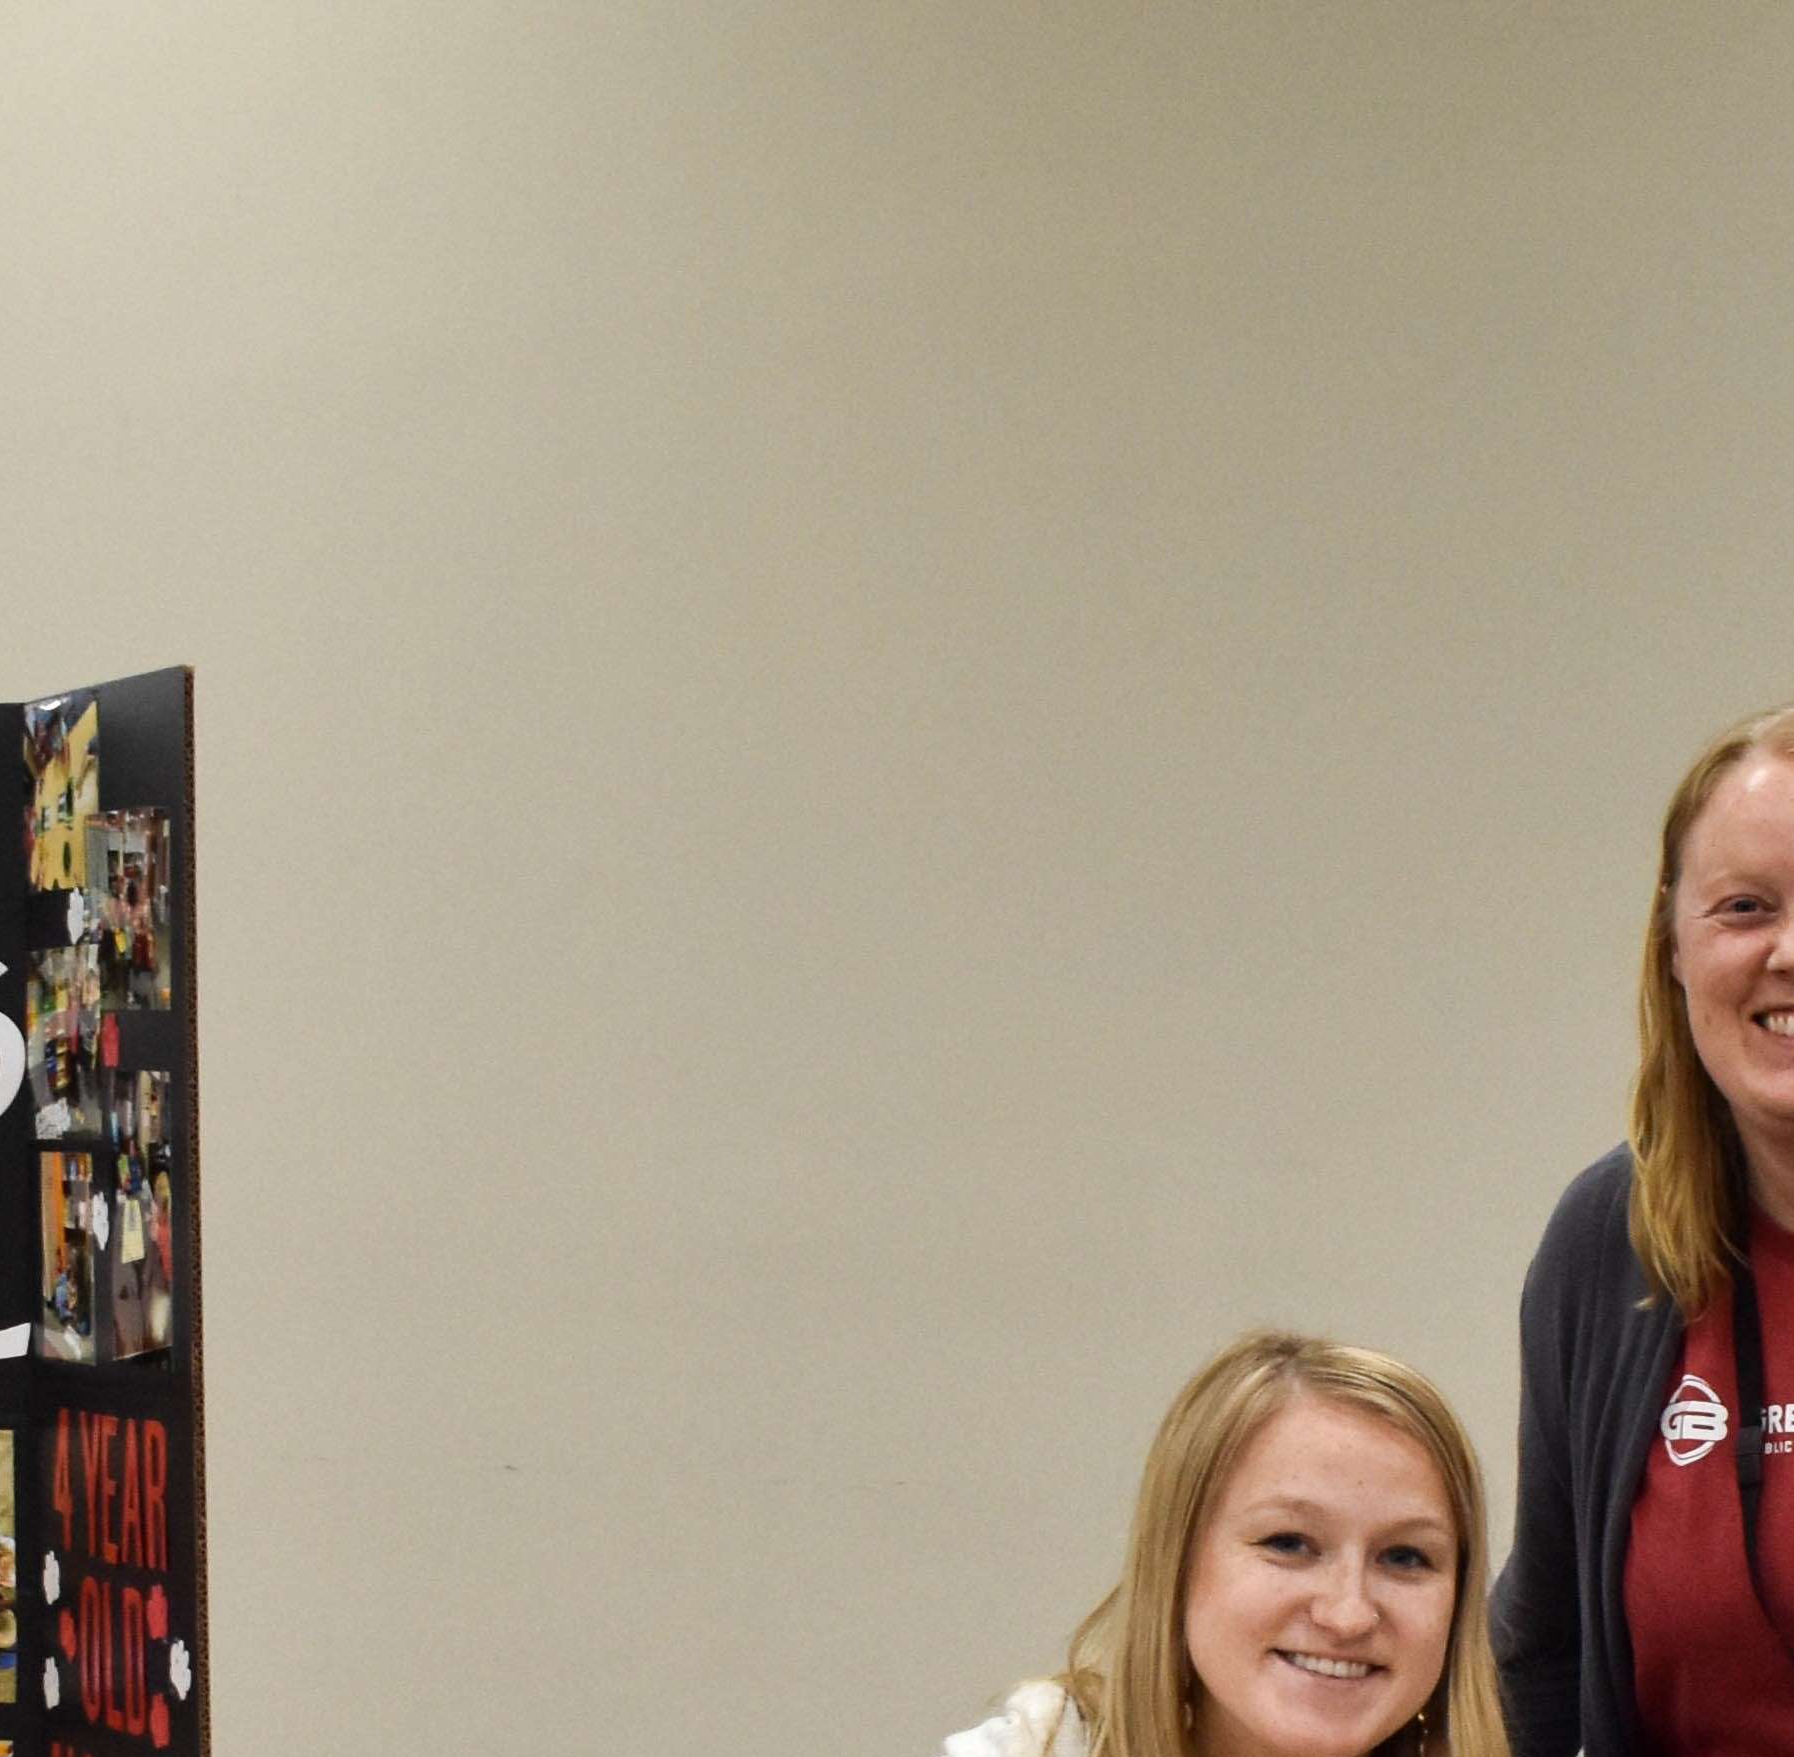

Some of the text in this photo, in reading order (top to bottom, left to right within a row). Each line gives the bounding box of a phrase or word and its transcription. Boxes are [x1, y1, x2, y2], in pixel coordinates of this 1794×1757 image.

[53, 1408, 167, 1570] 4 YEAR
[1764, 1442, 1793, 1455] BLIC
[78, 1576, 147, 1737] OLD
